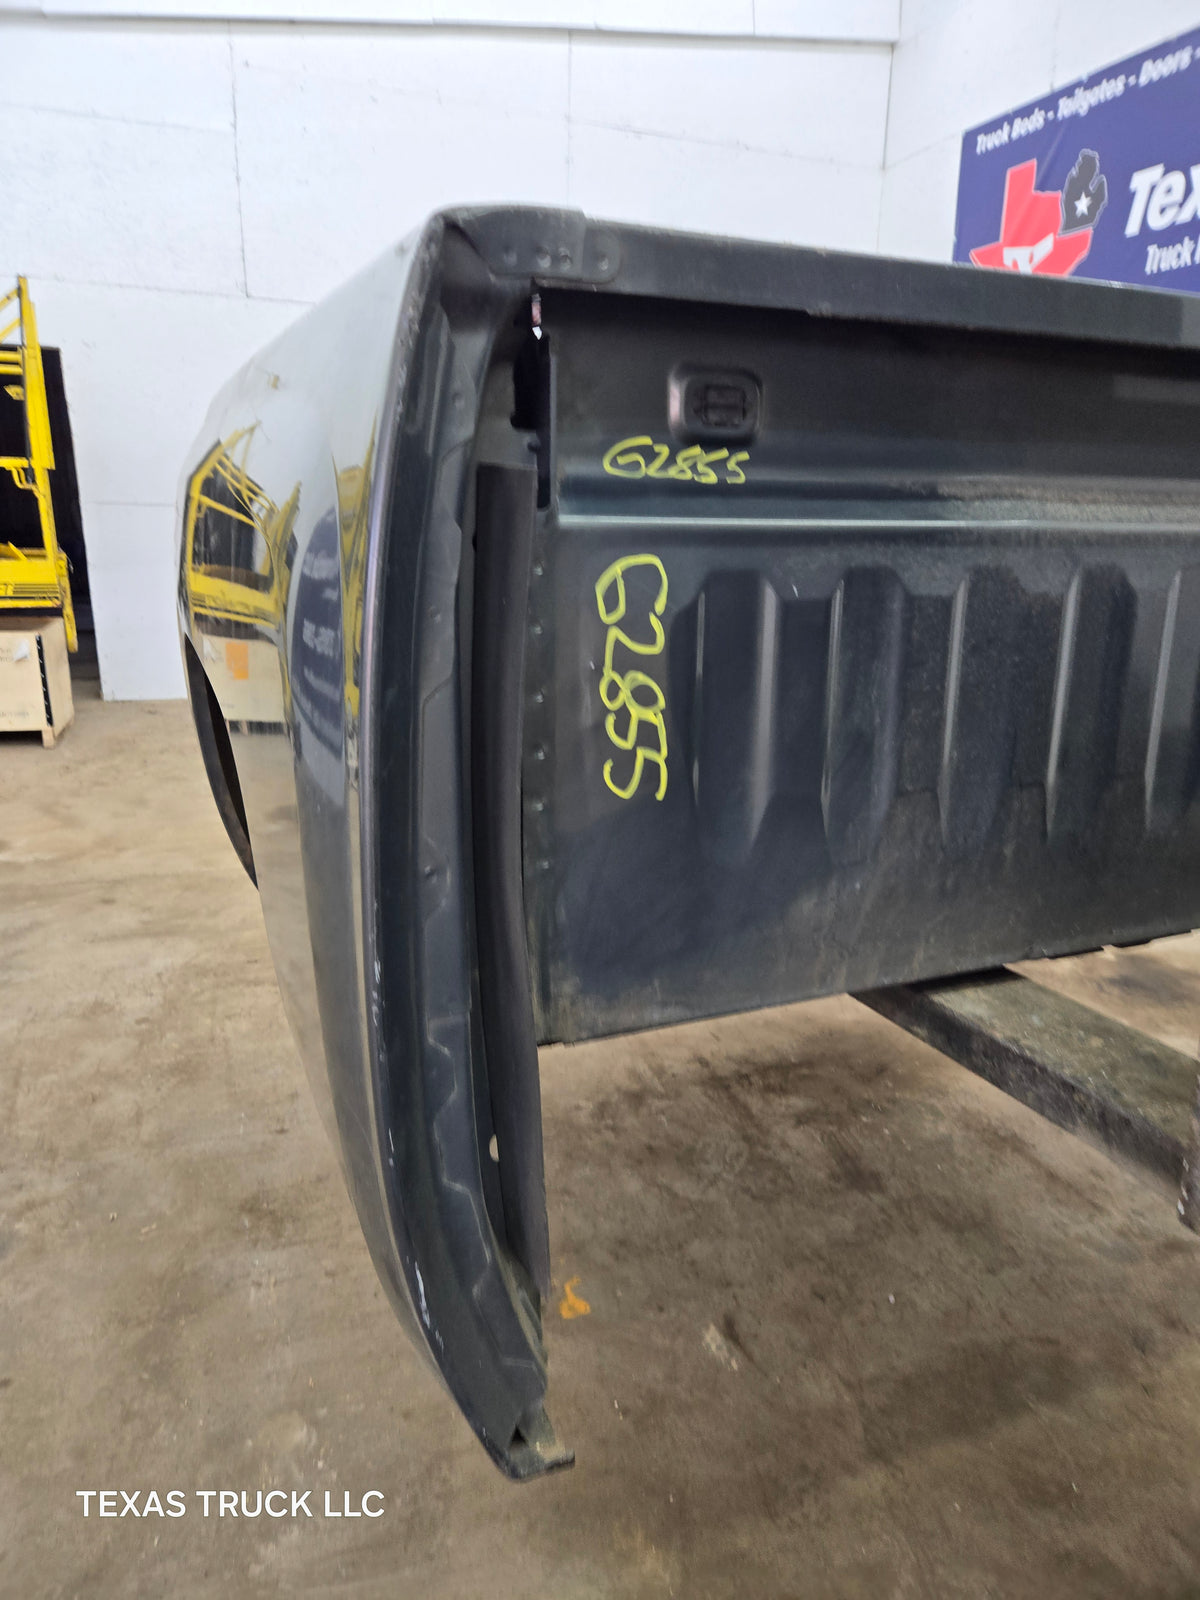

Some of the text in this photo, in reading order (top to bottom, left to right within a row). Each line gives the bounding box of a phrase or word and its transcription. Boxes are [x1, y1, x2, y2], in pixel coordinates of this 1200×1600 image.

[976, 121, 1010, 155] Truck
[1011, 107, 1045, 141] Beds
[1057, 74, 1126, 121] Tailgates
[1138, 45, 1193, 87] Doors
[1145, 236, 1195, 275] Truck
[604, 436, 750, 484] G2855
[595, 554, 668, 801] G2855
